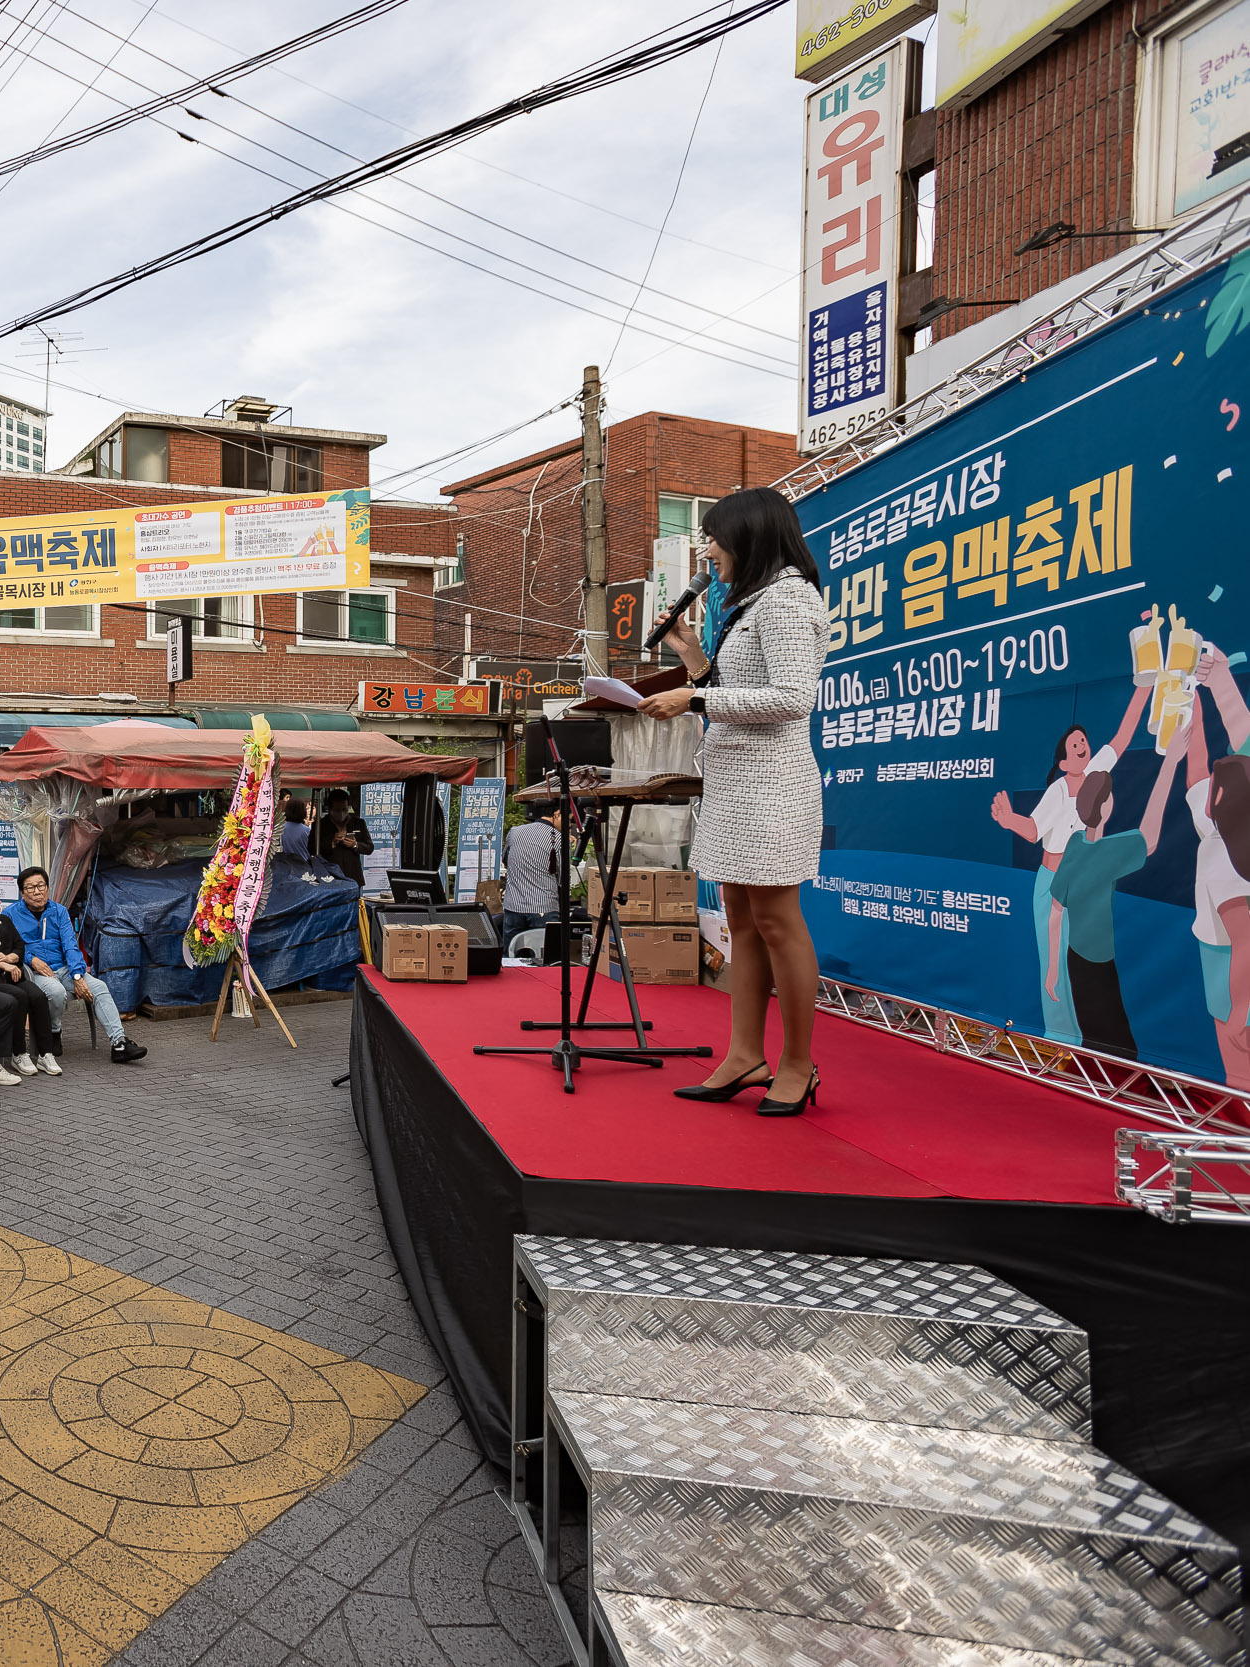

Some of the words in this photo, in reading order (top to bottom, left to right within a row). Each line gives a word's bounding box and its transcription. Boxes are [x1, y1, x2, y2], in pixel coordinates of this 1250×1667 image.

[819, 62, 886, 122] 대성
[817, 109, 885, 286] 유리
[141, 513, 170, 522] 초대가수
[171, 511, 186, 520] 공연
[829, 451, 1007, 570] 능동로골목시장
[901, 464, 1134, 630] 음맥축제
[51, 581, 64, 597] 내
[892, 625, 1069, 698] 16:00~19:00
[371, 685, 484, 712] 강남분식
[533, 681, 580, 697] Chicken
[822, 694, 966, 749] 능동로골목시장
[971, 688, 1001, 732] 내
[836, 768, 864, 784] 광진구
[876, 757, 995, 782] 능동로골목시장상인회
[843, 897, 861, 916] 정일,
[862, 900, 891, 921] 김정현,
[892, 905, 929, 927] 한유빈,
[931, 910, 970, 933] 이현남
[894, 886, 912, 903] 대상
[942, 890, 1011, 916] 홍삼트리오
